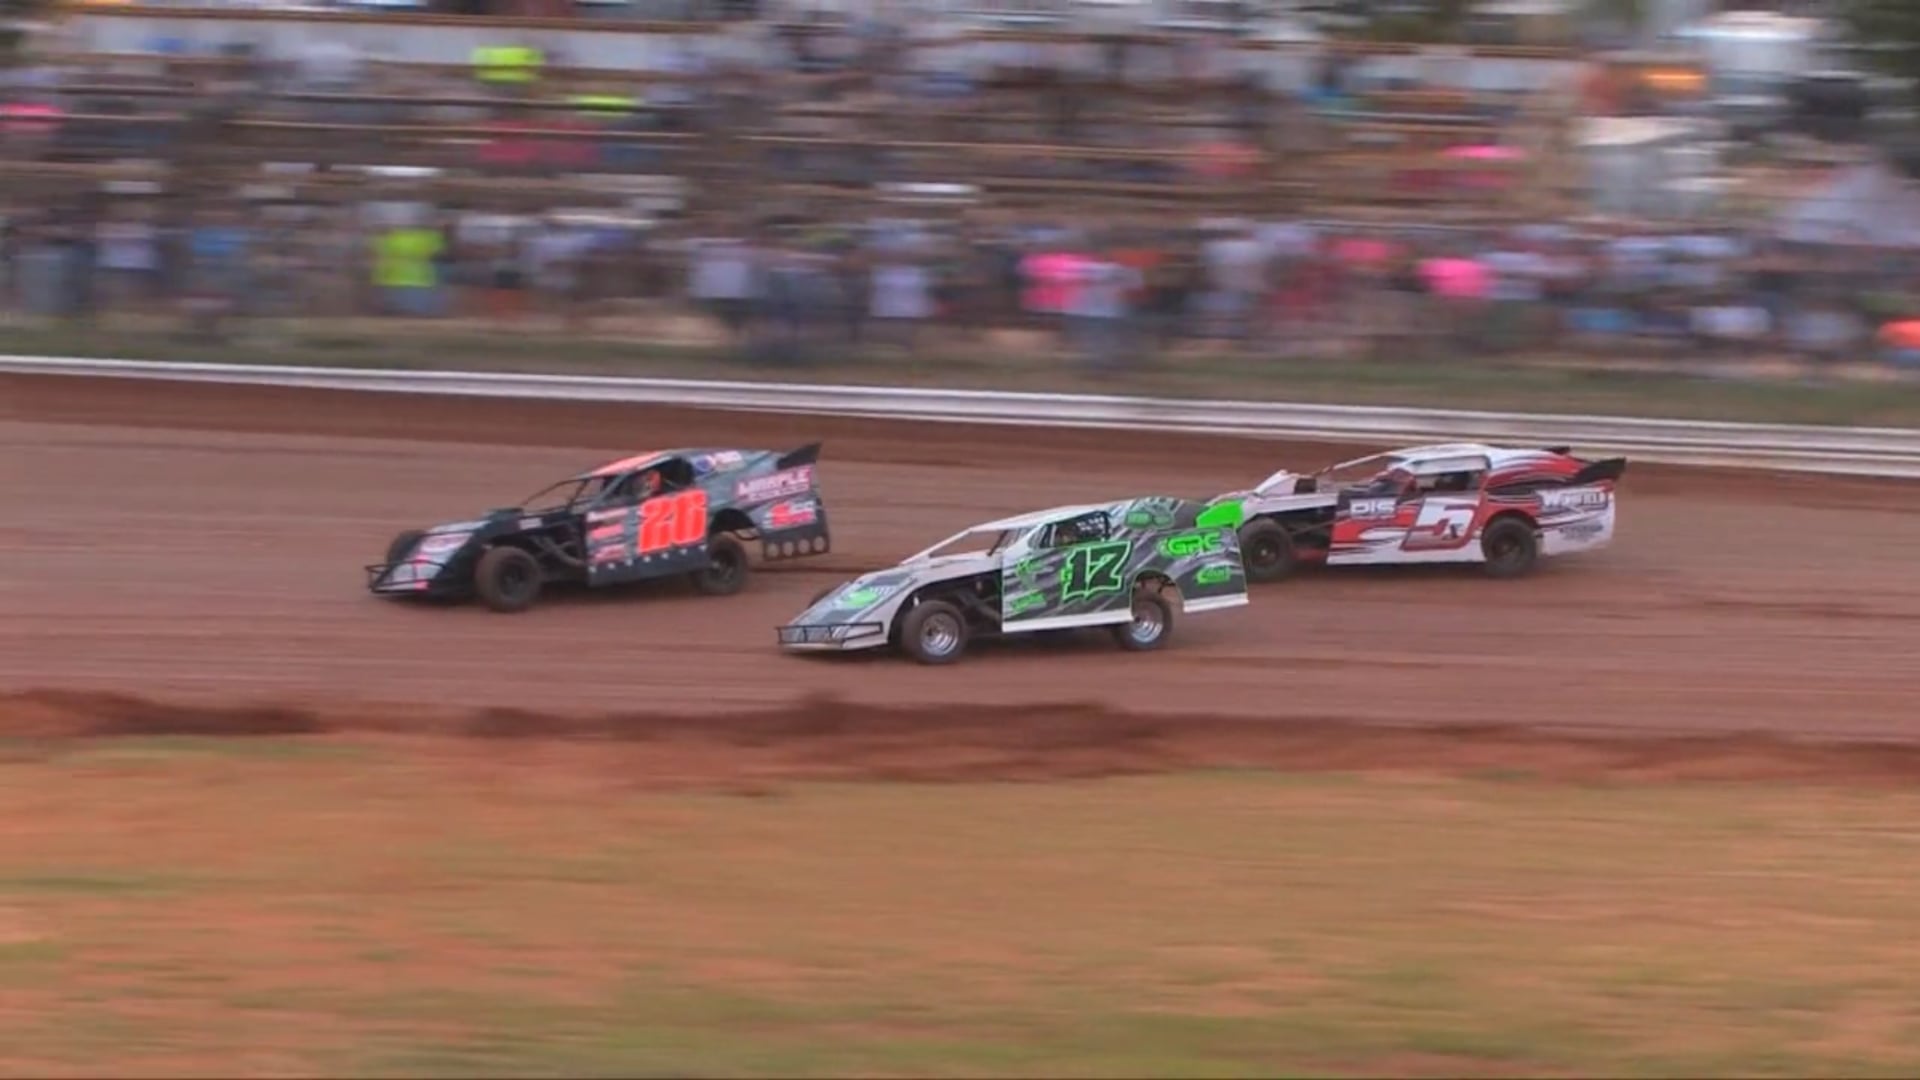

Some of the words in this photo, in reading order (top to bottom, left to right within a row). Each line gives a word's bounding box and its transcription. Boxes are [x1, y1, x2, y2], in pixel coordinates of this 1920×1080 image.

[638, 488, 708, 555] 26
[1402, 498, 1476, 551] 5
[1062, 540, 1131, 601] 17
